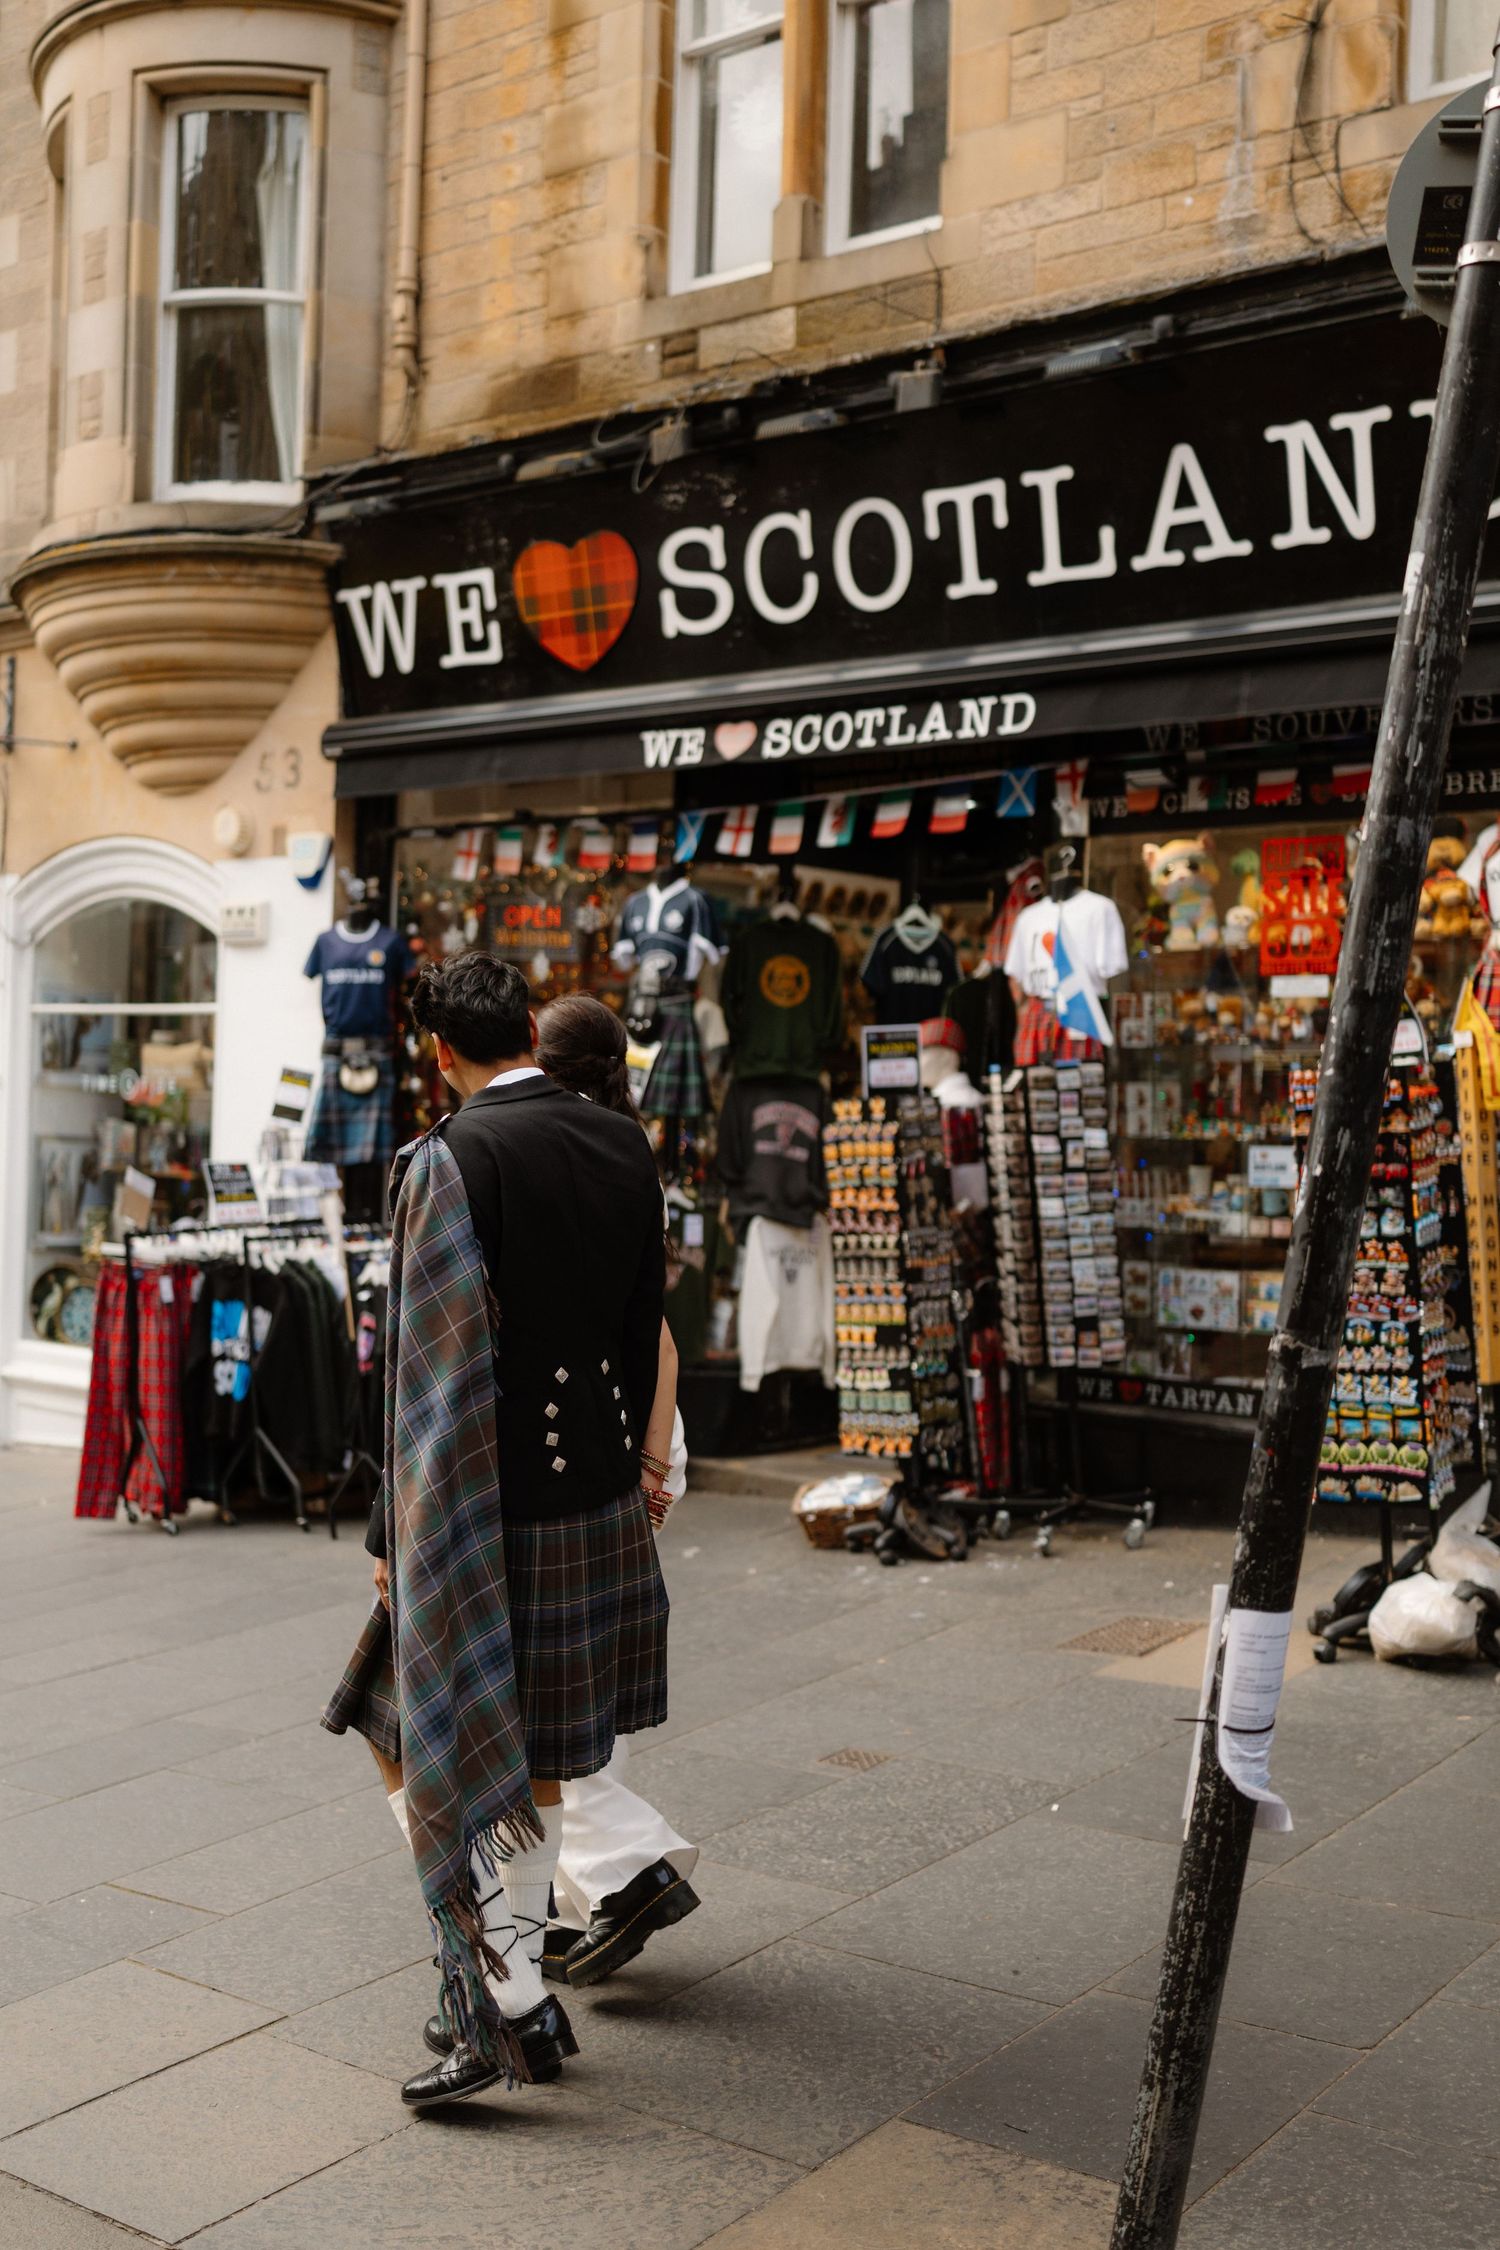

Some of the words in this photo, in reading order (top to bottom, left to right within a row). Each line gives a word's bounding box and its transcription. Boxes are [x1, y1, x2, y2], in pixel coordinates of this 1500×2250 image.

[336, 567, 503, 679] WE
[658, 400, 1500, 638] SCOTLAN
[640, 727, 706, 768] WE
[762, 692, 1037, 759] SCOTLAND
[1143, 722, 1199, 751] WE
[254, 747, 302, 793] 53
[503, 904, 561, 929] OPEN
[1263, 878, 1348, 920] SALE
[1077, 1375, 1114, 1398] WE
[1146, 1382, 1256, 1417] TARTAN
